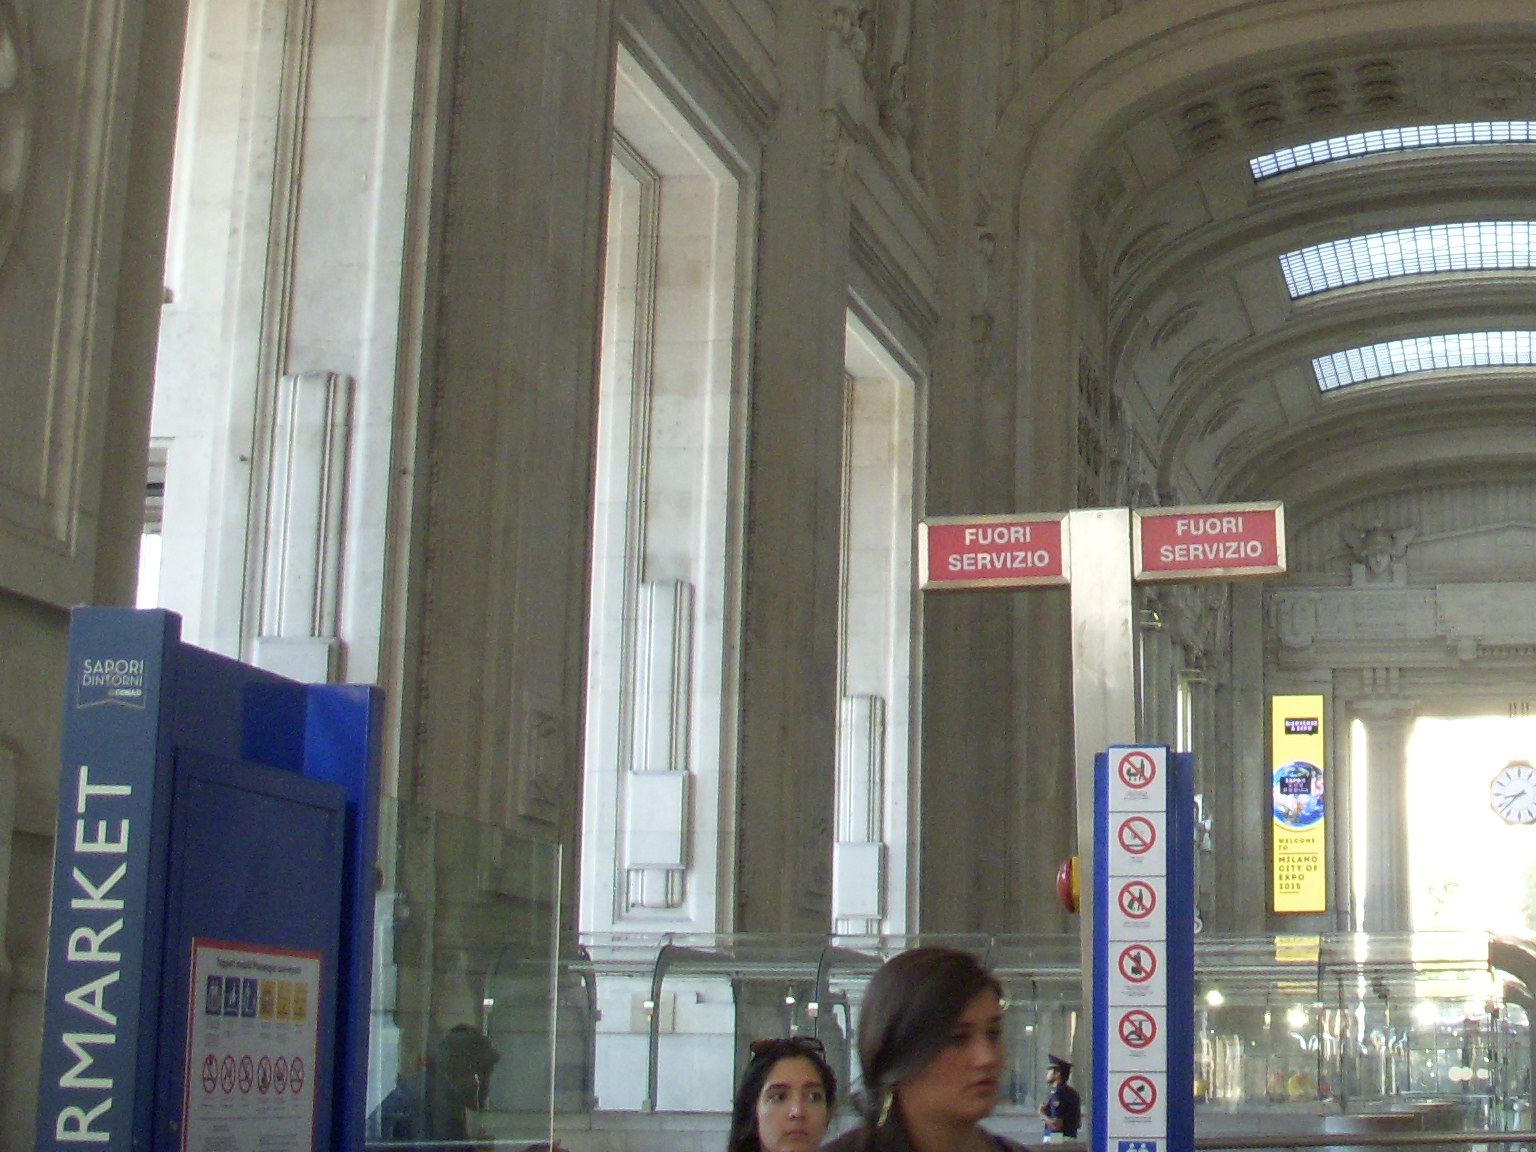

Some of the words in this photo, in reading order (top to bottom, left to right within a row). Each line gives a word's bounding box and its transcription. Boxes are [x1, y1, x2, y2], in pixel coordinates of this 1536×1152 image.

[964, 526, 1032, 546] FUORI
[1177, 516, 1243, 537] FUORI
[947, 550, 1050, 572] SERVIZIO
[1159, 539, 1264, 563] SERVIZIO
[83, 658, 144, 675] SAPORI
[82, 673, 143, 687] DINTORNI
[1278, 864, 1302, 872] CITY
[1306, 864, 1319, 872] OF
[1278, 873, 1305, 881] EXPO
[56, 765, 133, 1142] RMARKET
